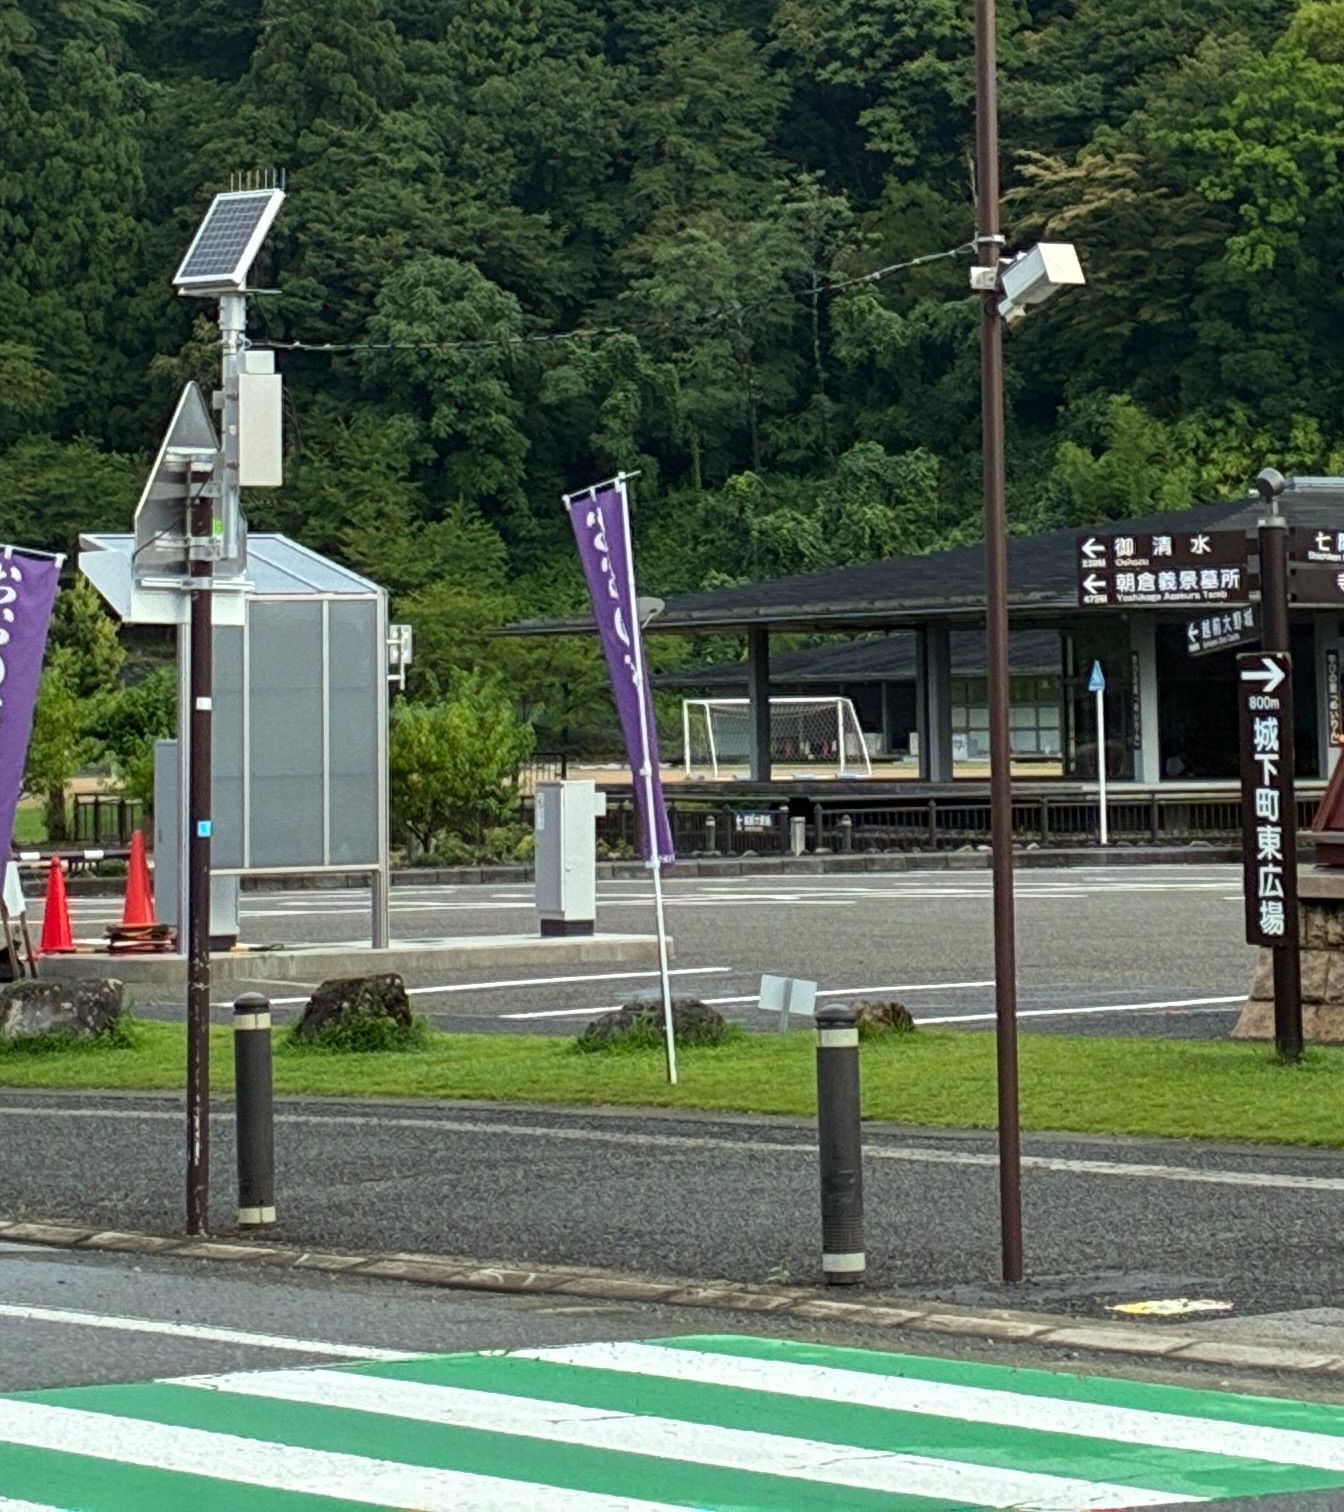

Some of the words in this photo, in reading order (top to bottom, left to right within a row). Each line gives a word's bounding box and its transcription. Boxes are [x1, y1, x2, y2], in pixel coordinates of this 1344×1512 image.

[1114, 534, 1212, 557] 御清水
[1116, 568, 1241, 593] 朝倉義景墓所
[1249, 696, 1280, 710] 800m
[1253, 716, 1285, 936] 城下町東広場
